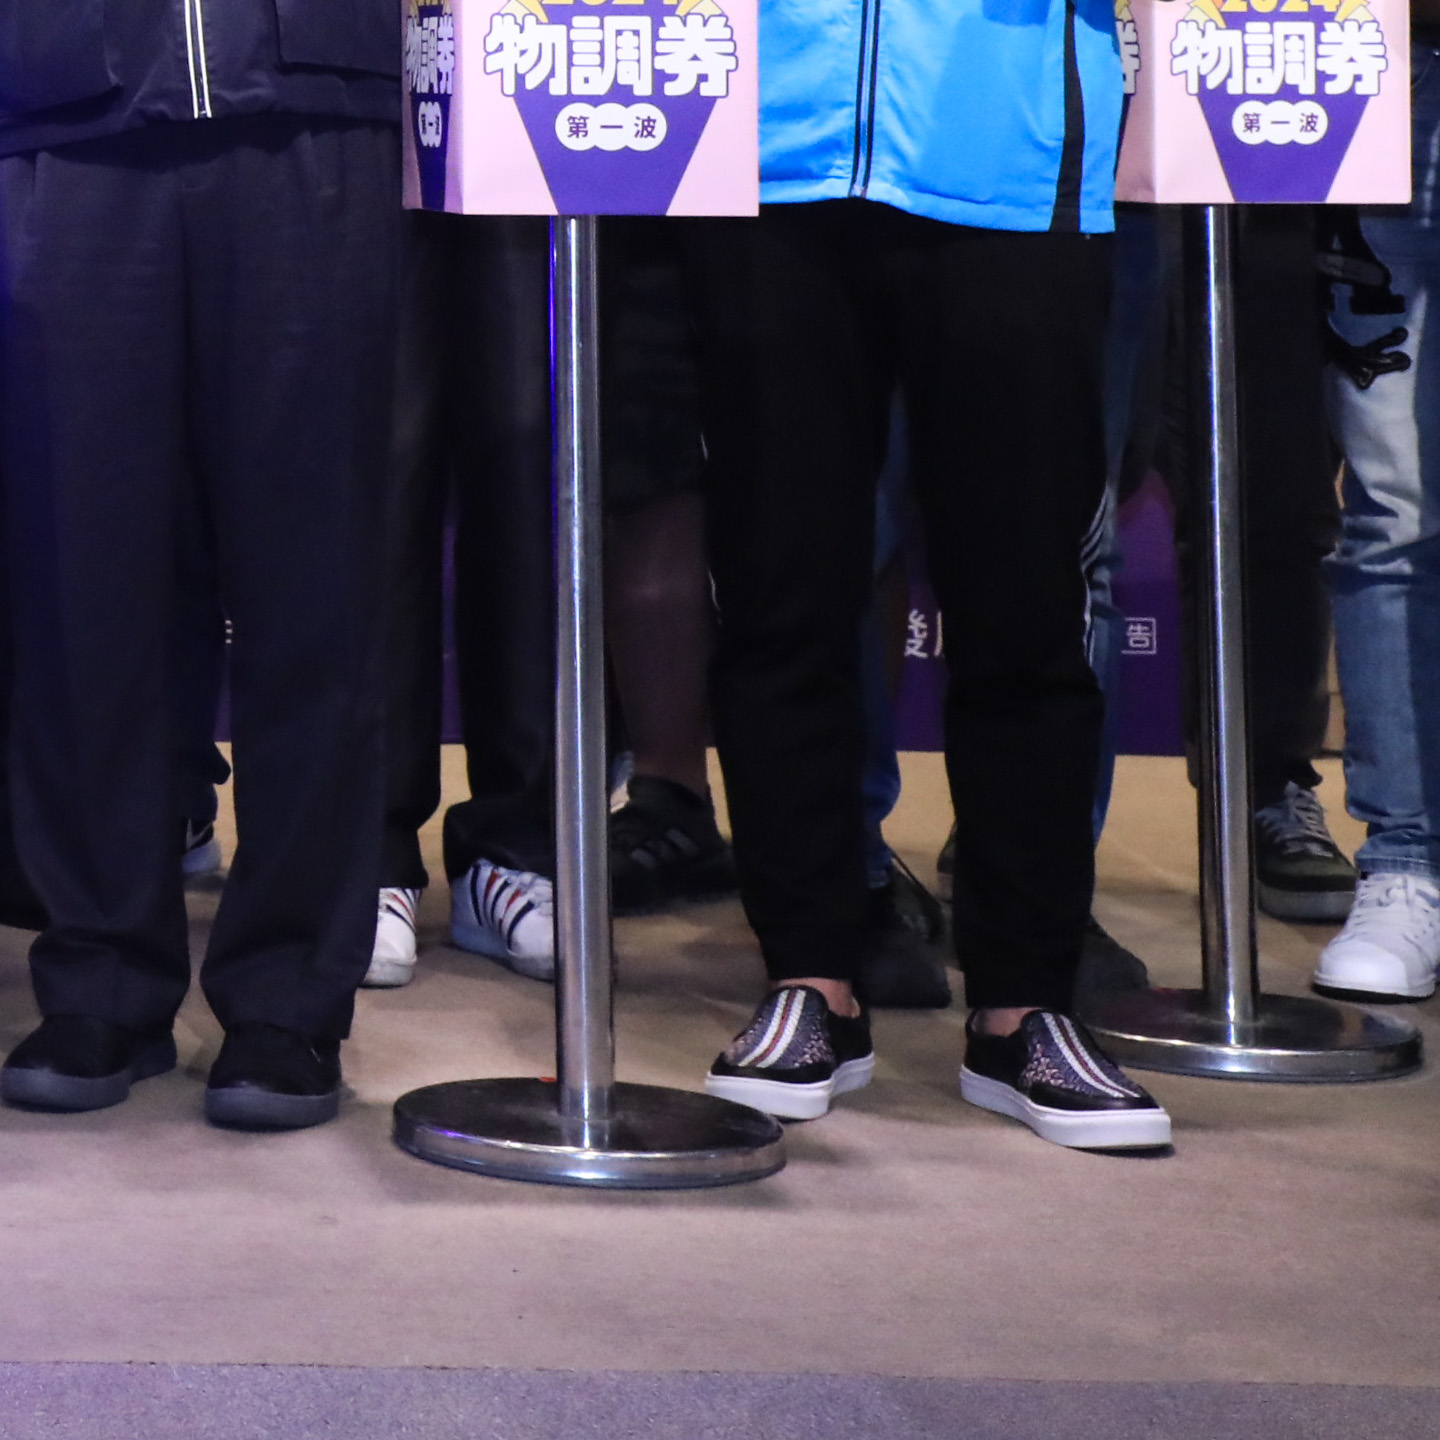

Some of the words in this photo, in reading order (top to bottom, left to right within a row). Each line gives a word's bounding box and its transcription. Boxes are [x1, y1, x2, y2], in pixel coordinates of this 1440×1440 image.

[483, 13, 739, 97] 物調券
[1170, 19, 1388, 96] 物調券
[567, 115, 658, 140] 第一波
[1242, 112, 1319, 133] 第一波
